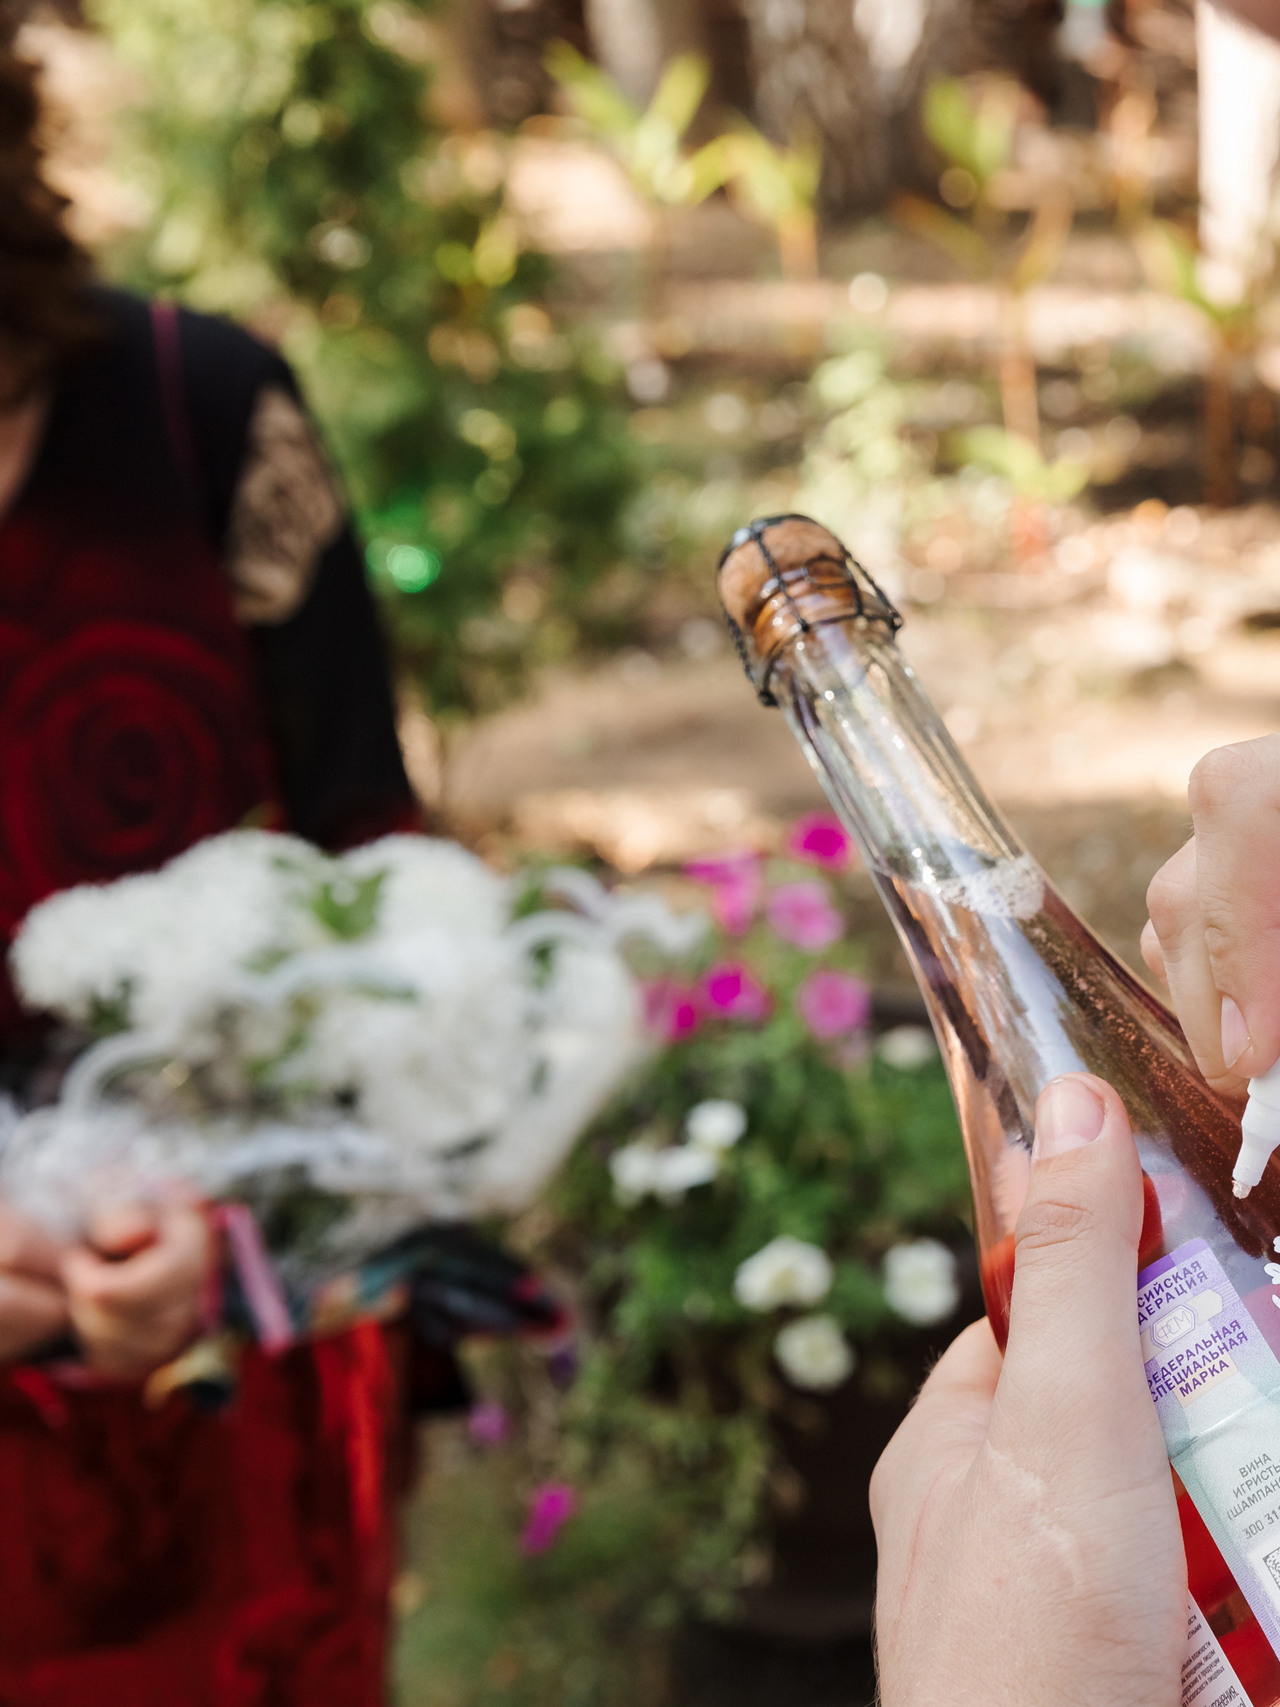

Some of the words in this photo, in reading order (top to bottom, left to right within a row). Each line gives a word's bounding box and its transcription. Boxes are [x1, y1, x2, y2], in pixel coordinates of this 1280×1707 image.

[1137, 1259, 1203, 1308] СИЙСКАЯ
[1137, 1270, 1209, 1325] ДЕРАЦИЯ
[1179, 1359, 1230, 1398] МАРКА
[1239, 1452, 1272, 1480] ВИНА
[1242, 1518, 1266, 1540] 300
